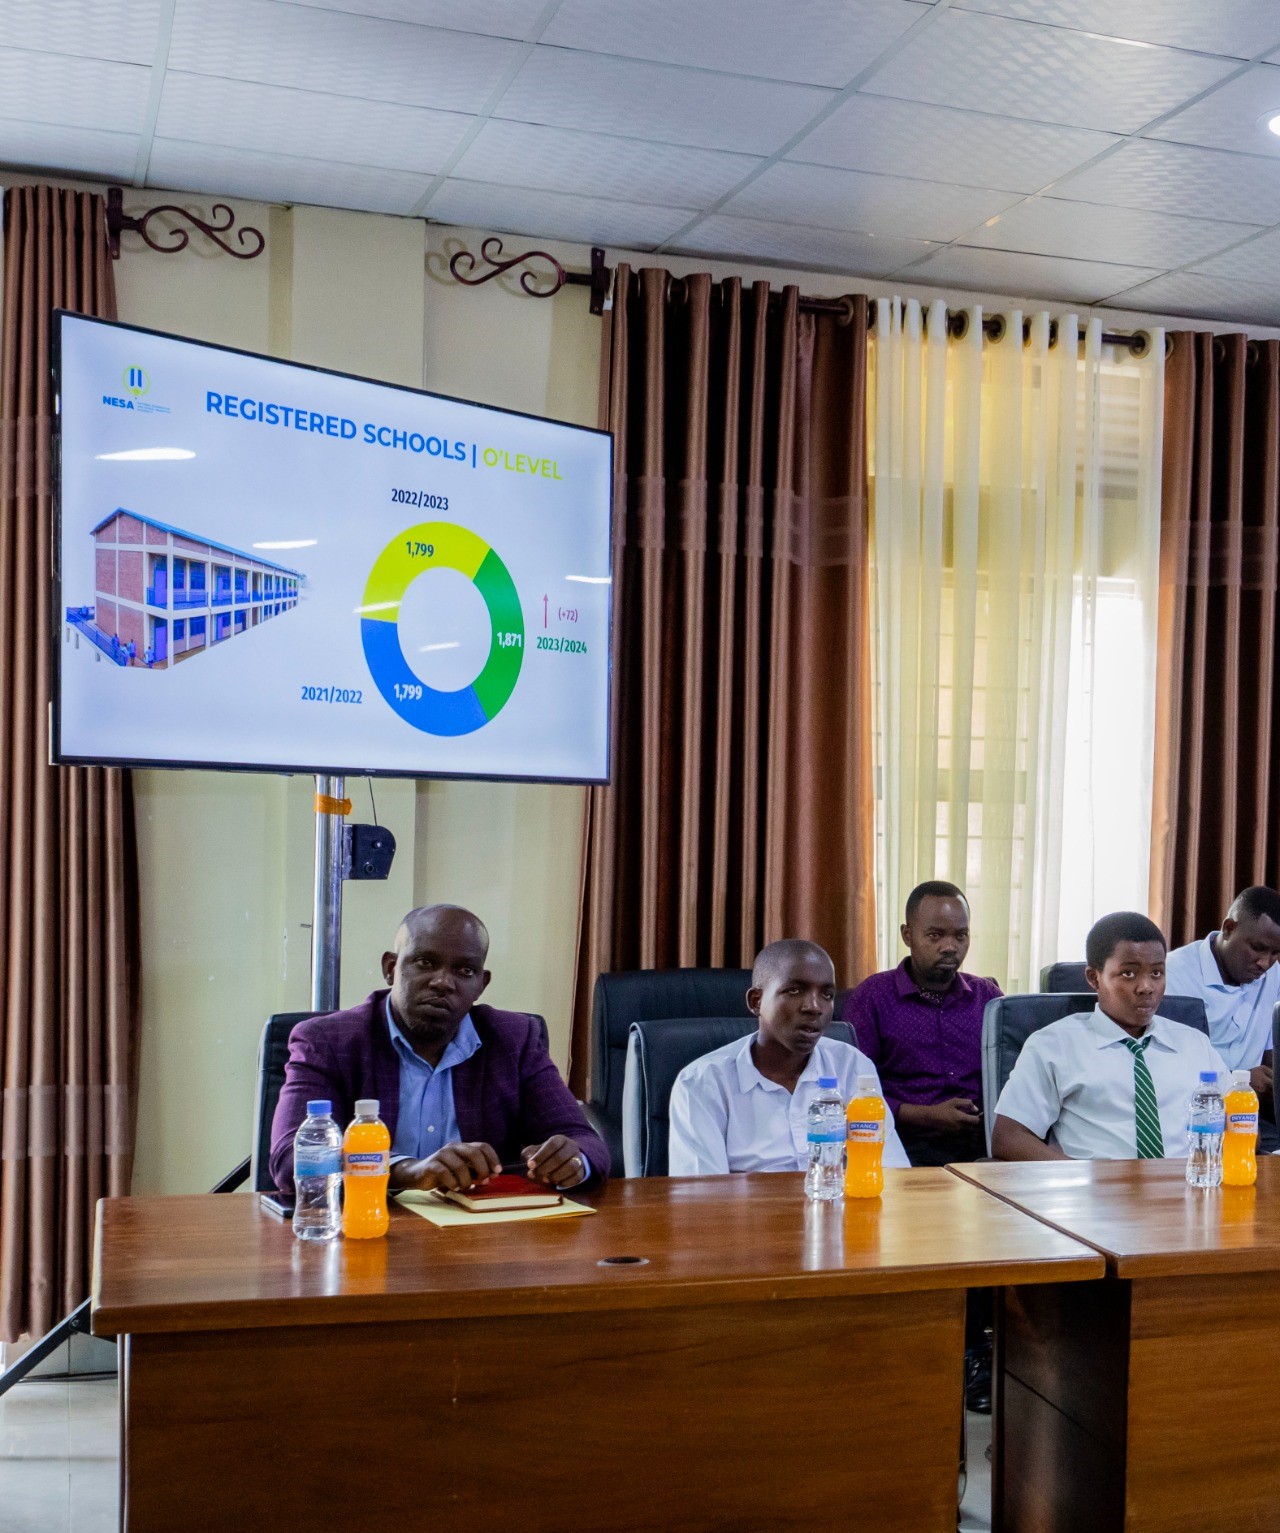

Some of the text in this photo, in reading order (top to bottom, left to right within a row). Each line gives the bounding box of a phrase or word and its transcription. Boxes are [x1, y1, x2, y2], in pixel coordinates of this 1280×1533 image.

[102, 395, 135, 410] NESA
[206, 391, 357, 440] REGISTERED
[363, 423, 466, 461] SCHOOLS
[483, 447, 564, 481] O'LEVEL
[391, 488, 449, 511] 2022/2023
[406, 541, 435, 558] 1,799
[558, 607, 578, 623] (+72)
[497, 632, 522, 648] 1,871
[536, 636, 587, 654] 2023/2024
[301, 686, 363, 704] 2021/2022
[393, 683, 422, 702] 1,799
